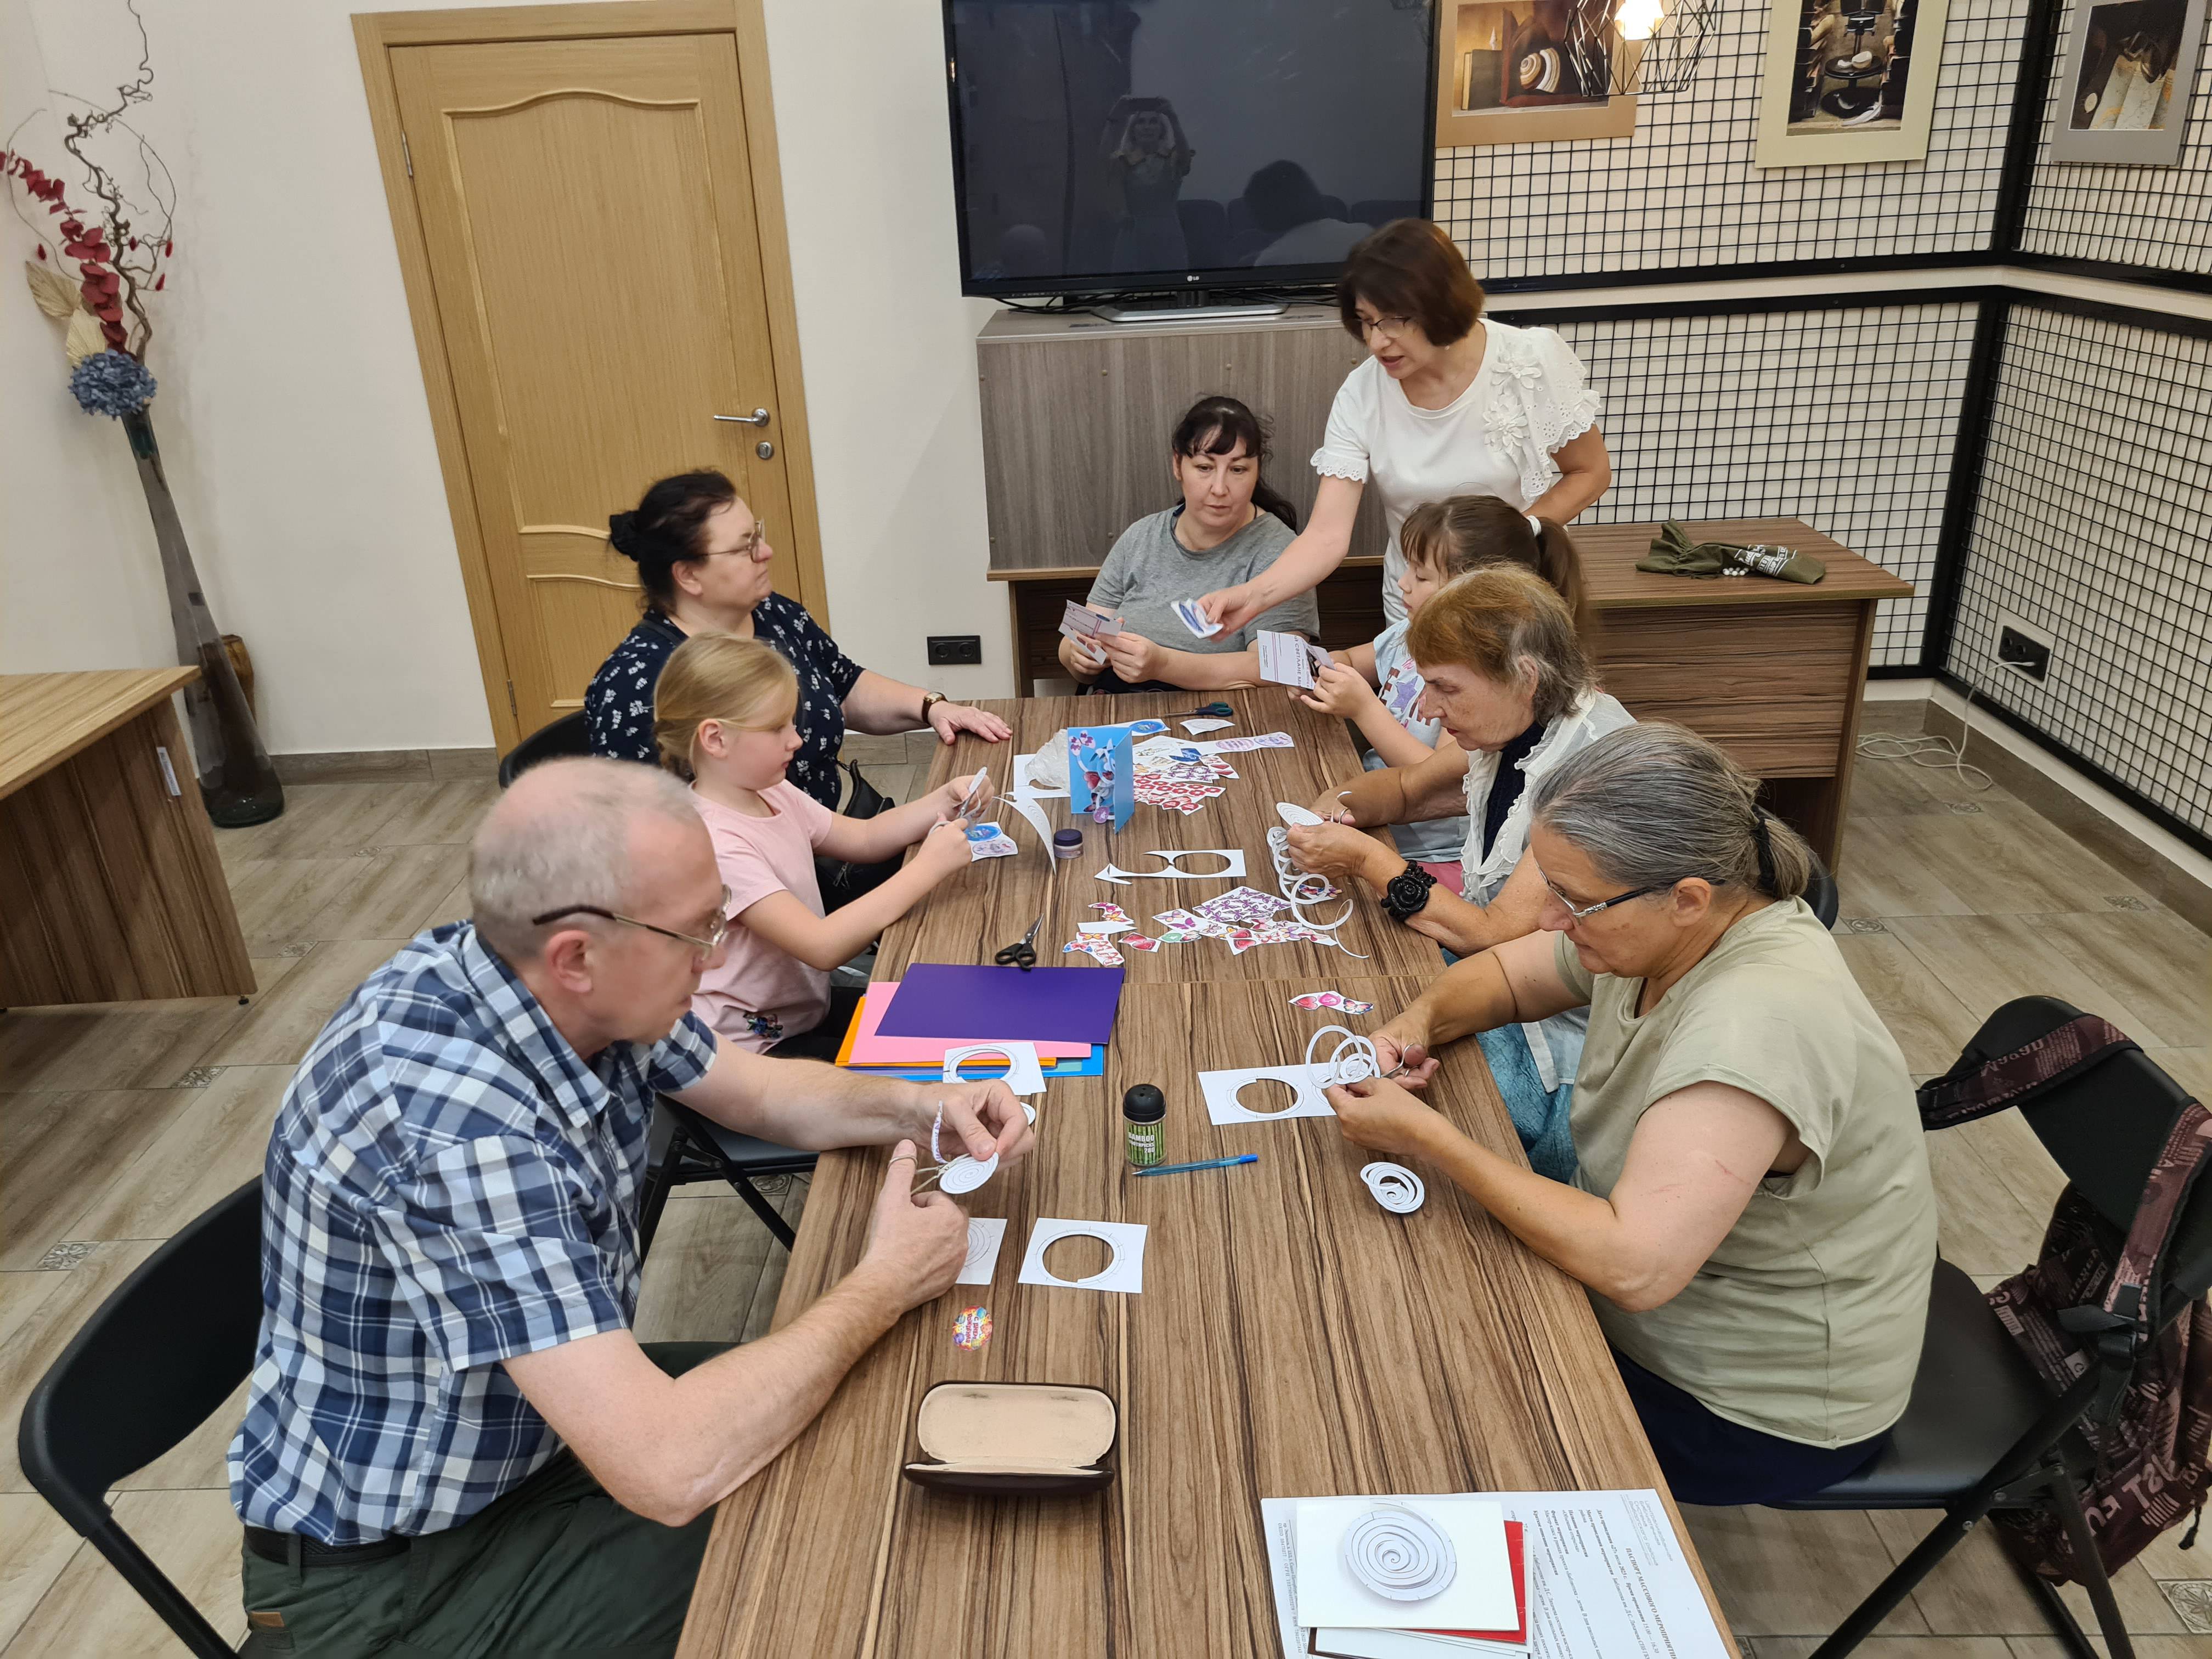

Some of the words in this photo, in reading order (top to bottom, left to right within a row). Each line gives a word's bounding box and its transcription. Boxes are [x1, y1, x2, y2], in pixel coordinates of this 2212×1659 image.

[1128, 1132, 1155, 1142] BAMBOO
[1626, 1548, 1641, 1575] ПАСПОРТ
[1638, 1576, 1657, 1613] МАССОВОГО
